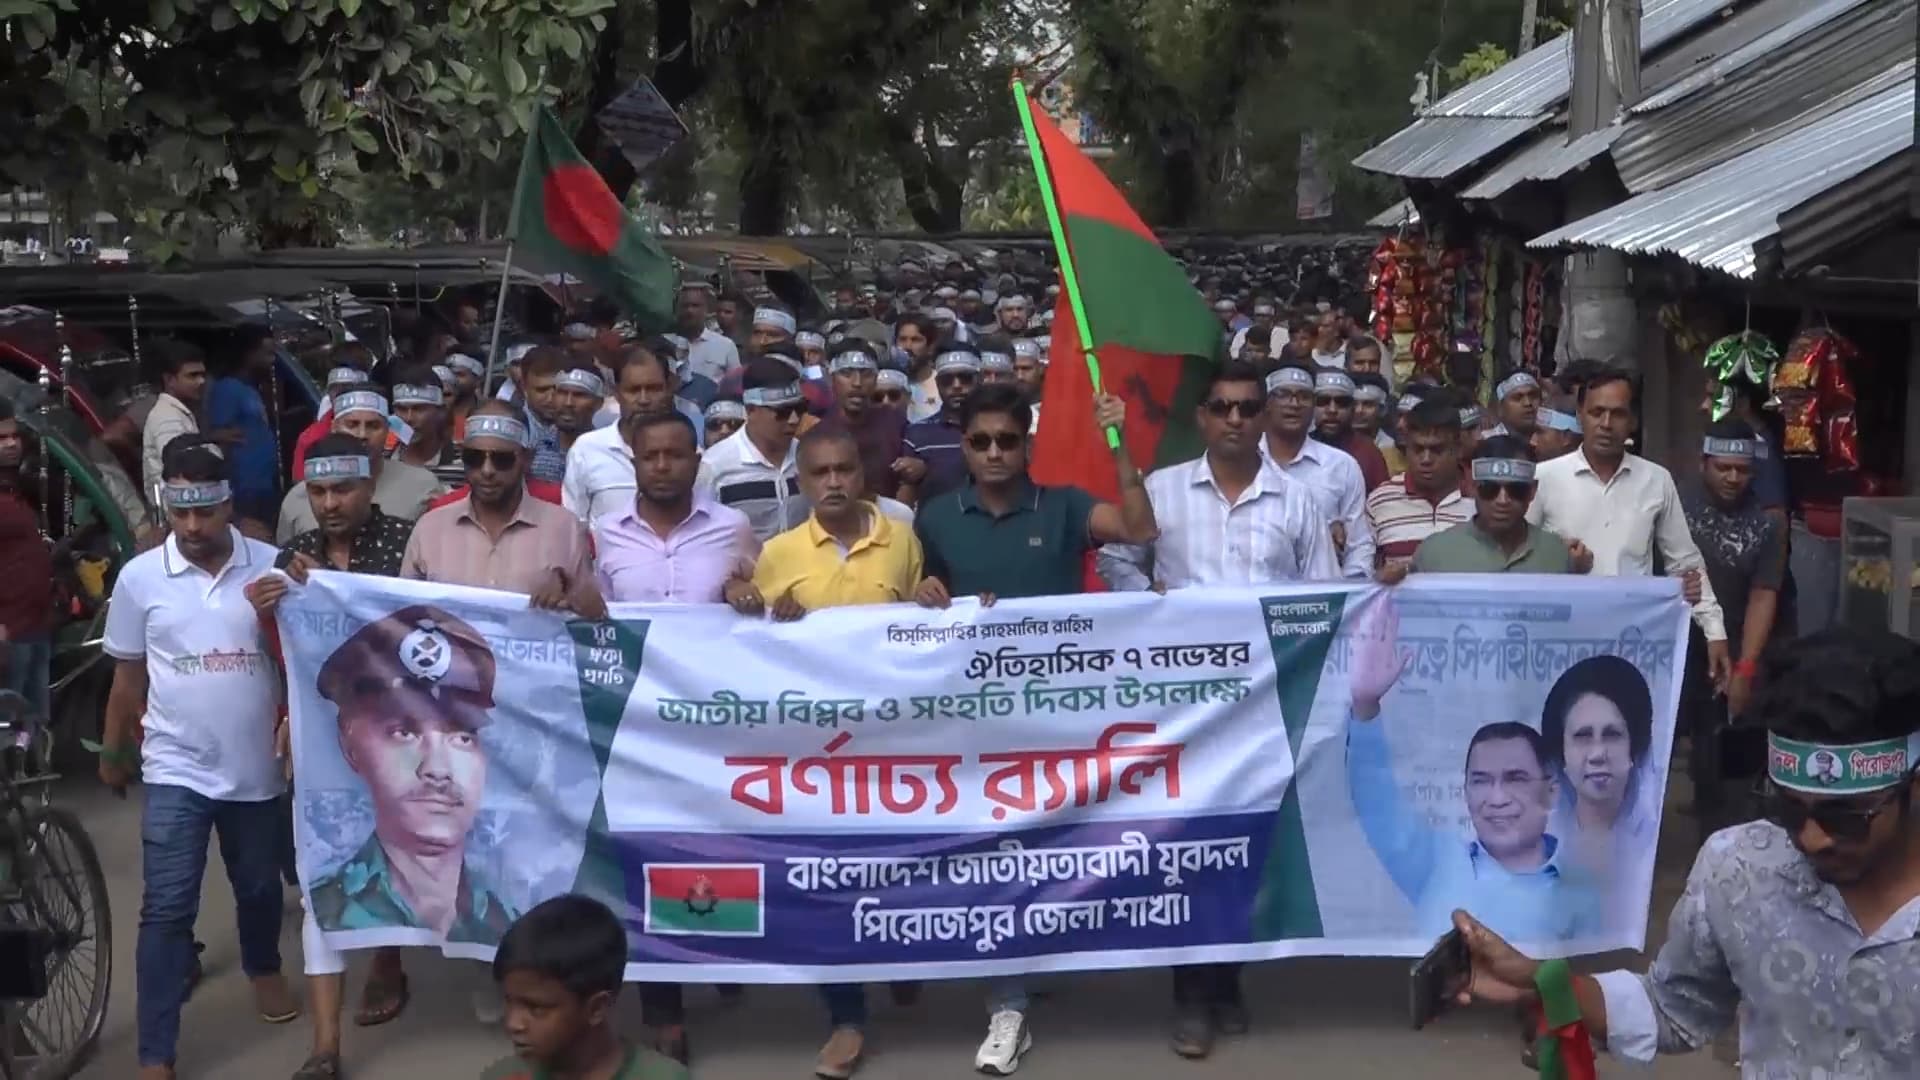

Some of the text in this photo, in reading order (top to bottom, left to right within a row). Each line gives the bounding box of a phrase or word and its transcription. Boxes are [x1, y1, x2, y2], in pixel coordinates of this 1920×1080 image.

[980, 616, 1049, 640] রাহমানির
[1052, 614, 1094, 634] রাহিম
[1268, 601, 1330, 618] বাংলাদেশ
[1270, 619, 1332, 637] জিন্দাবাদ
[964, 641, 1251, 680] ঐতিহাসিক ৭ নভেম্বর
[656, 689, 769, 728] জাতীয়
[776, 690, 865, 728] বিপ্লব
[875, 697, 901, 722] ও
[910, 682, 1016, 721] সংহতি
[1022, 679, 1107, 716] দিবস
[724, 731, 963, 815] বর্ণাঢ্য
[785, 831, 1251, 890] বাংলাদেশ জাতীয়তাবাদী যুবদল
[852, 896, 1016, 953] পিরোজপুর
[1024, 899, 1107, 937] জেলা
